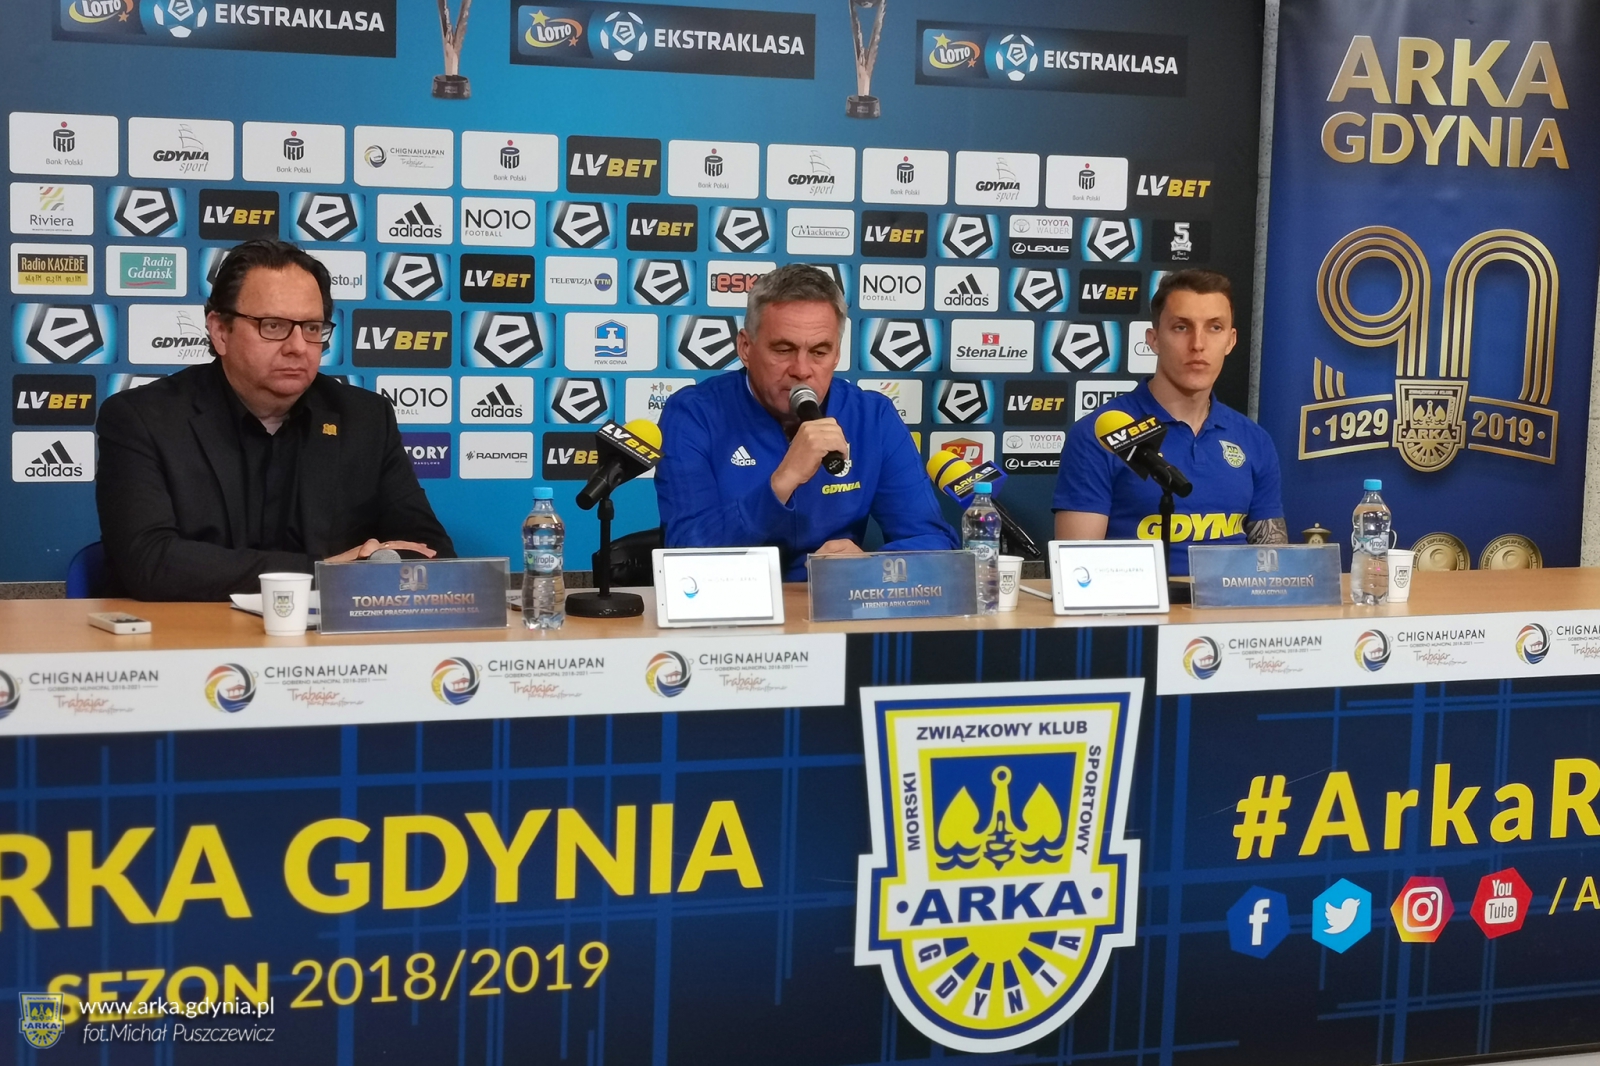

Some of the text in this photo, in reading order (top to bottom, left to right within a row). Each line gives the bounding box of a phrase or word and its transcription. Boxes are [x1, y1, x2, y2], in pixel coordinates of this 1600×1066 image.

[82, 0, 121, 18] LOTTO
[215, 3, 385, 33] EKSTRAKLASA
[537, 23, 572, 42] LOTTO
[654, 28, 805, 56] EKSTRAKLASA
[940, 46, 971, 63] LOTTO
[1043, 50, 1179, 75] EKSTRAKLASA
[1326, 35, 1570, 110] ARKA
[1320, 111, 1570, 170] GDYNIA
[153, 150, 210, 163] GDYNIA
[390, 147, 445, 156] CHIGNAHUAPAN
[46, 158, 84, 167] Bank Polski
[178, 160, 209, 174] sport
[295, 166, 312, 174] Polski
[569, 153, 658, 178] LVBET
[509, 174, 527, 182] Polski
[698, 181, 730, 190] Bank Polski
[788, 174, 835, 186] GDYNIA
[809, 184, 834, 196] sport
[975, 180, 1021, 192] GDYNIA
[1136, 175, 1211, 198] LVBET
[995, 190, 1020, 203] sport
[29, 214, 75, 228] Riviera
[203, 205, 276, 225] LVBET
[464, 209, 531, 230] NO10
[1036, 218, 1070, 227] TOYOTA
[389, 224, 442, 239] adidas
[464, 230, 503, 238] FOOTBALL
[630, 218, 694, 237] LVBET
[864, 225, 925, 243] LVBET
[1036, 227, 1070, 236] WALDER
[1174, 222, 1190, 243] 5
[1023, 244, 1070, 254] LEXUS
[21, 256, 46, 271] Radio
[142, 256, 174, 267] Radio
[127, 267, 174, 280] Gdańsk
[463, 269, 531, 288] LVBET
[549, 277, 613, 287] TELEWIZJA TTM
[863, 274, 922, 295] NO10
[862, 294, 897, 302] FOOTBALL
[1082, 283, 1138, 301] LVBET
[944, 293, 990, 307] adidas
[1314, 225, 1560, 406] 90
[151, 336, 209, 349] GDYNIA
[355, 326, 449, 351] LVBET
[177, 346, 208, 360] sport
[956, 345, 1028, 359] Stena Line
[16, 391, 92, 410] LVBET
[381, 387, 448, 408] NO10
[1007, 395, 1064, 412] LVBET
[471, 404, 523, 419] adidas
[1105, 417, 1157, 447] LVBET
[1324, 408, 1389, 442] 1929
[1471, 411, 1535, 446] 2019
[1404, 427, 1453, 440] ARKA
[602, 422, 661, 461] LVBET
[1029, 434, 1062, 442] TOYOTA
[403, 446, 449, 460] TORY
[475, 452, 528, 460] RADMOR
[546, 447, 598, 465] LVBE
[730, 456, 757, 467] adidas
[1020, 460, 1060, 468] LEXUS
[24, 463, 83, 478] adidas
[821, 480, 861, 494] GDYNIA
[953, 472, 984, 493] ARKA
[533, 554, 555, 566] Kropla
[1222, 574, 1314, 588] DAMIAN ZBOZIEŃ
[352, 591, 475, 608] TOMASZ RYBIŃSKI
[848, 584, 943, 601] JACEK ZIELIŃSKI
[349, 609, 384, 618] RZECZNIK
[384, 608, 420, 617] PRASOWY
[1397, 629, 1486, 642] CHIGNAHUAPAN
[1556, 625, 1600, 636] CHIGNA
[1228, 635, 1322, 649] CHIGNAHUAPAN
[488, 657, 605, 671] CHIGNAHUAPAN
[699, 651, 808, 665] CHIGNAHUAPAN
[1245, 656, 1285, 672] Trabajar
[1413, 649, 1450, 665] Trabajar
[29, 670, 159, 685] CHIGNAHUAPAN
[264, 664, 388, 678] CHIGNAHUAPAN
[509, 679, 559, 698] Trabajar
[719, 672, 766, 690] Trabajar
[53, 692, 109, 712] Trabajar
[287, 686, 340, 705] Trabajar
[916, 720, 1088, 743] ZWIĄZKOWY KLUB
[1075, 744, 1102, 856] SPORTOWY
[902, 771, 921, 852] MORSKI
[0, 800, 764, 931] RKA GDYNIA
[1491, 879, 1513, 897] You
[909, 880, 1088, 927] ARKA
[1488, 901, 1515, 920] Tube
[47, 940, 610, 1026] SEZON 2018/2019
[918, 934, 1082, 1017] GDYNIA
